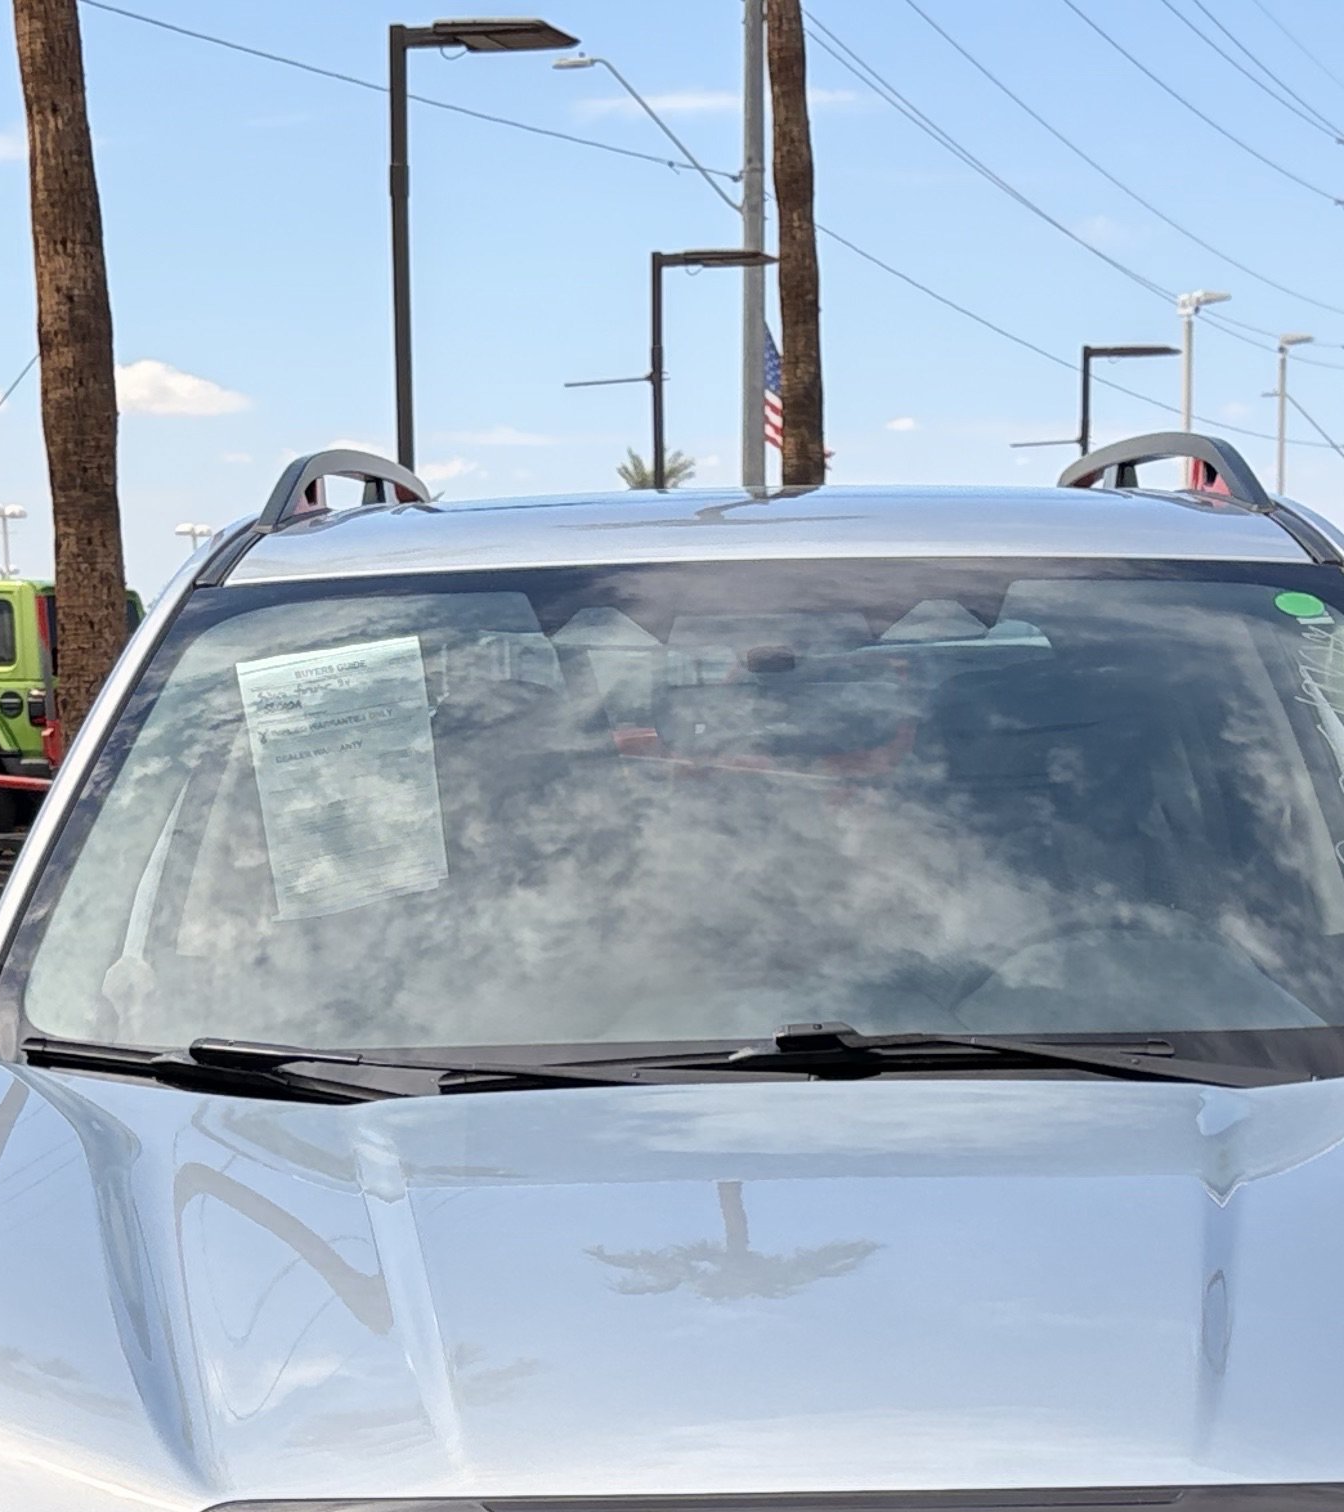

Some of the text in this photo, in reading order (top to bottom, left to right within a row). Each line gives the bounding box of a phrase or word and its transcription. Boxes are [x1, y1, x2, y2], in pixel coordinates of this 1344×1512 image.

[294, 659, 368, 679] BUYERS GUIDE
[315, 740, 364, 757] WAANTY
